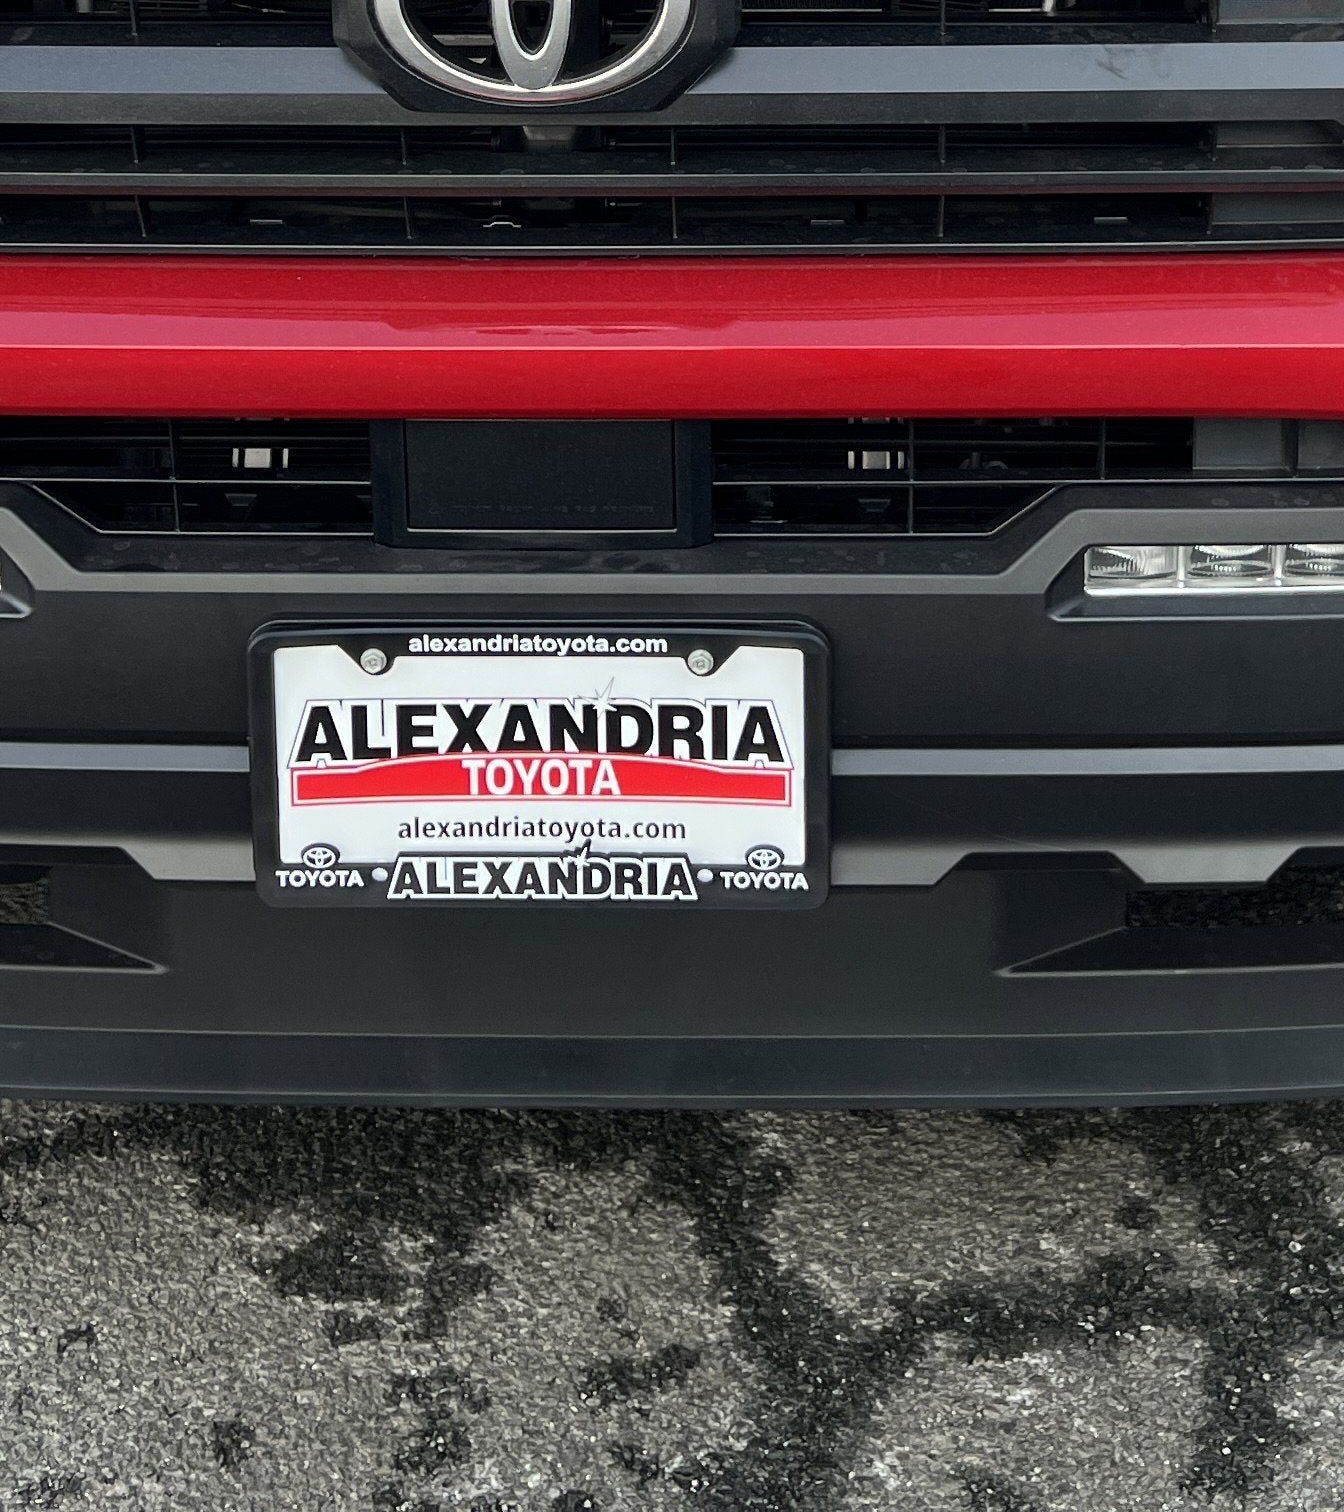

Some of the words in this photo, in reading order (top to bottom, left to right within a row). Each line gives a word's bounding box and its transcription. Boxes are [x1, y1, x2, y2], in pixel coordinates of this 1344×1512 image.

[409, 635, 667, 656] alexandriatoyota.com
[294, 702, 792, 765] ALEXANDRIA
[462, 758, 622, 796] TOYOTA
[398, 816, 687, 845] alexandriatoyota.com
[276, 870, 364, 888] TOYOTA
[388, 856, 698, 900] ALEXANDRIA
[720, 872, 809, 890] TOYOTA
